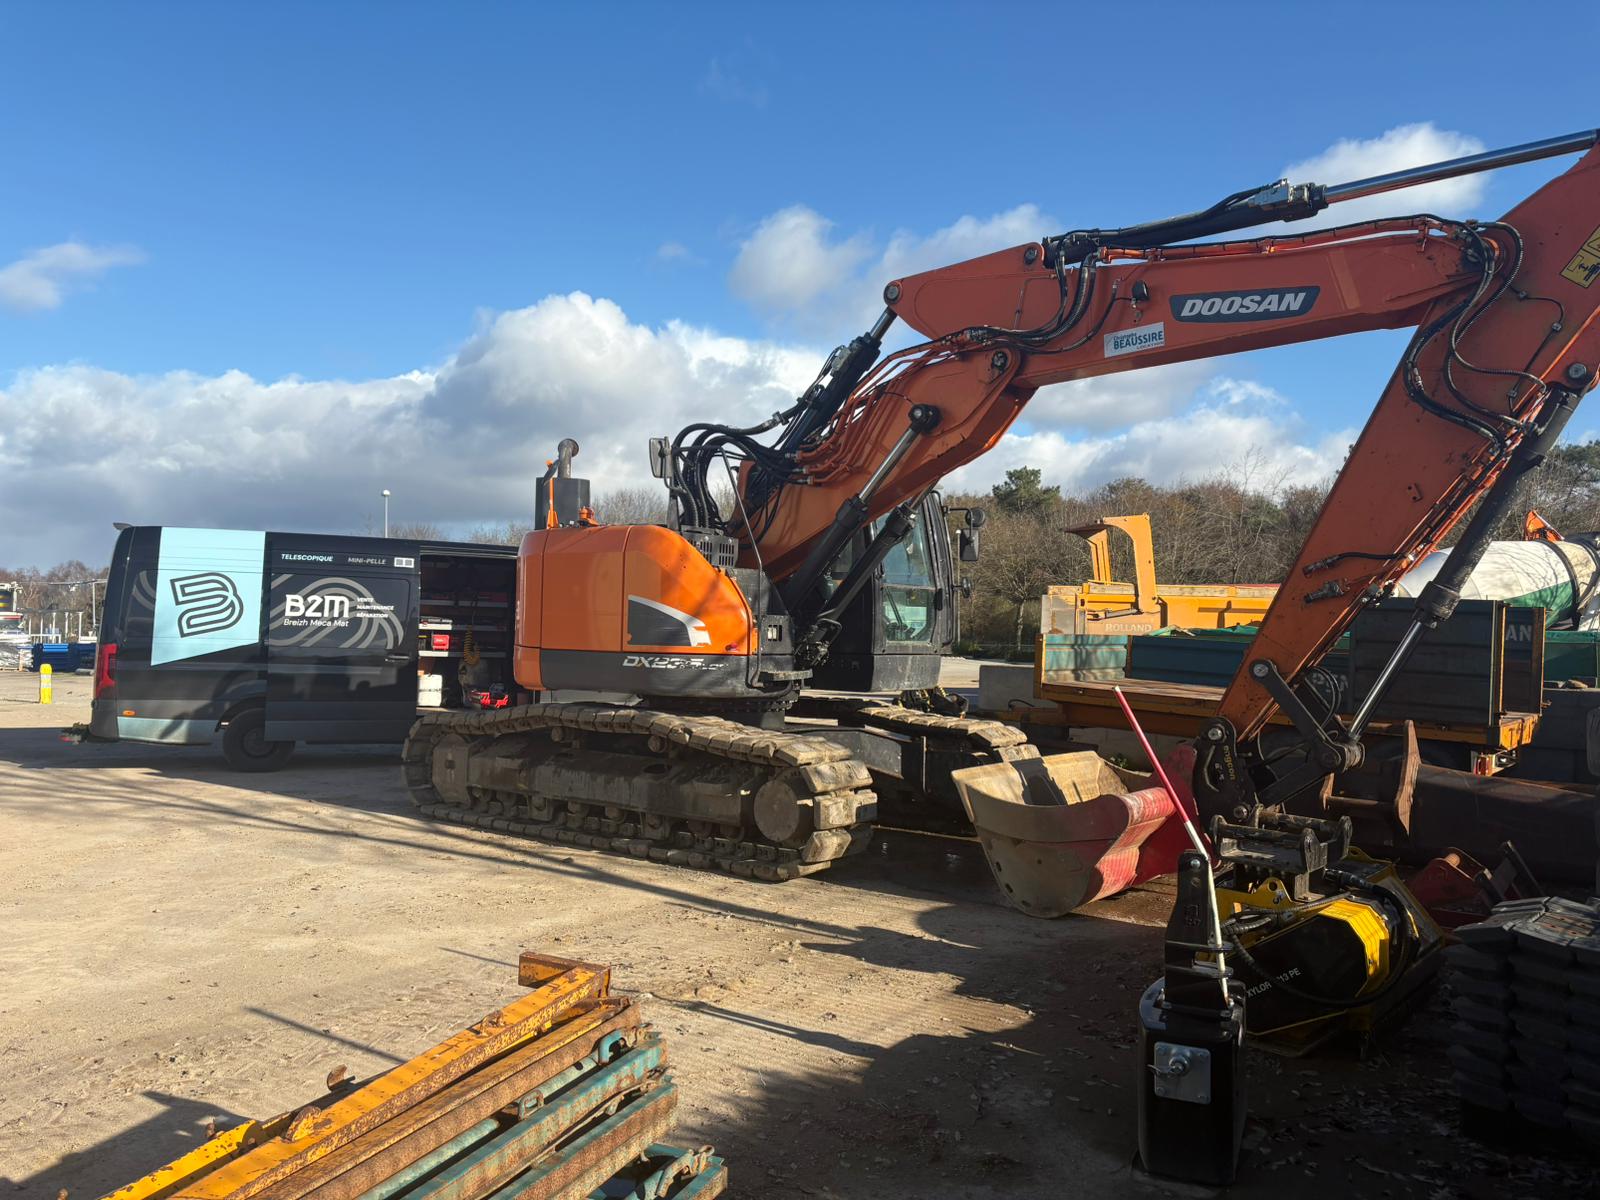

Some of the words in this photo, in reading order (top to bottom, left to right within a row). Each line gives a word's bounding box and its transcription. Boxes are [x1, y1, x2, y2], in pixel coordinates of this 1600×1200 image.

[1180, 292, 1307, 317] DOOSAN
[1113, 331, 1163, 350] BEAUSSIRE
[281, 553, 334, 562] TELESCOPIQUE
[347, 556, 387, 565] MINI-PELLE
[283, 618, 308, 626] Breizh
[333, 620, 349, 628] Mat
[1105, 623, 1152, 632] ROLLAND
[1223, 744, 1236, 780] engcon
[1246, 981, 1273, 998] XYLOR
[1288, 967, 1302, 979] PE
